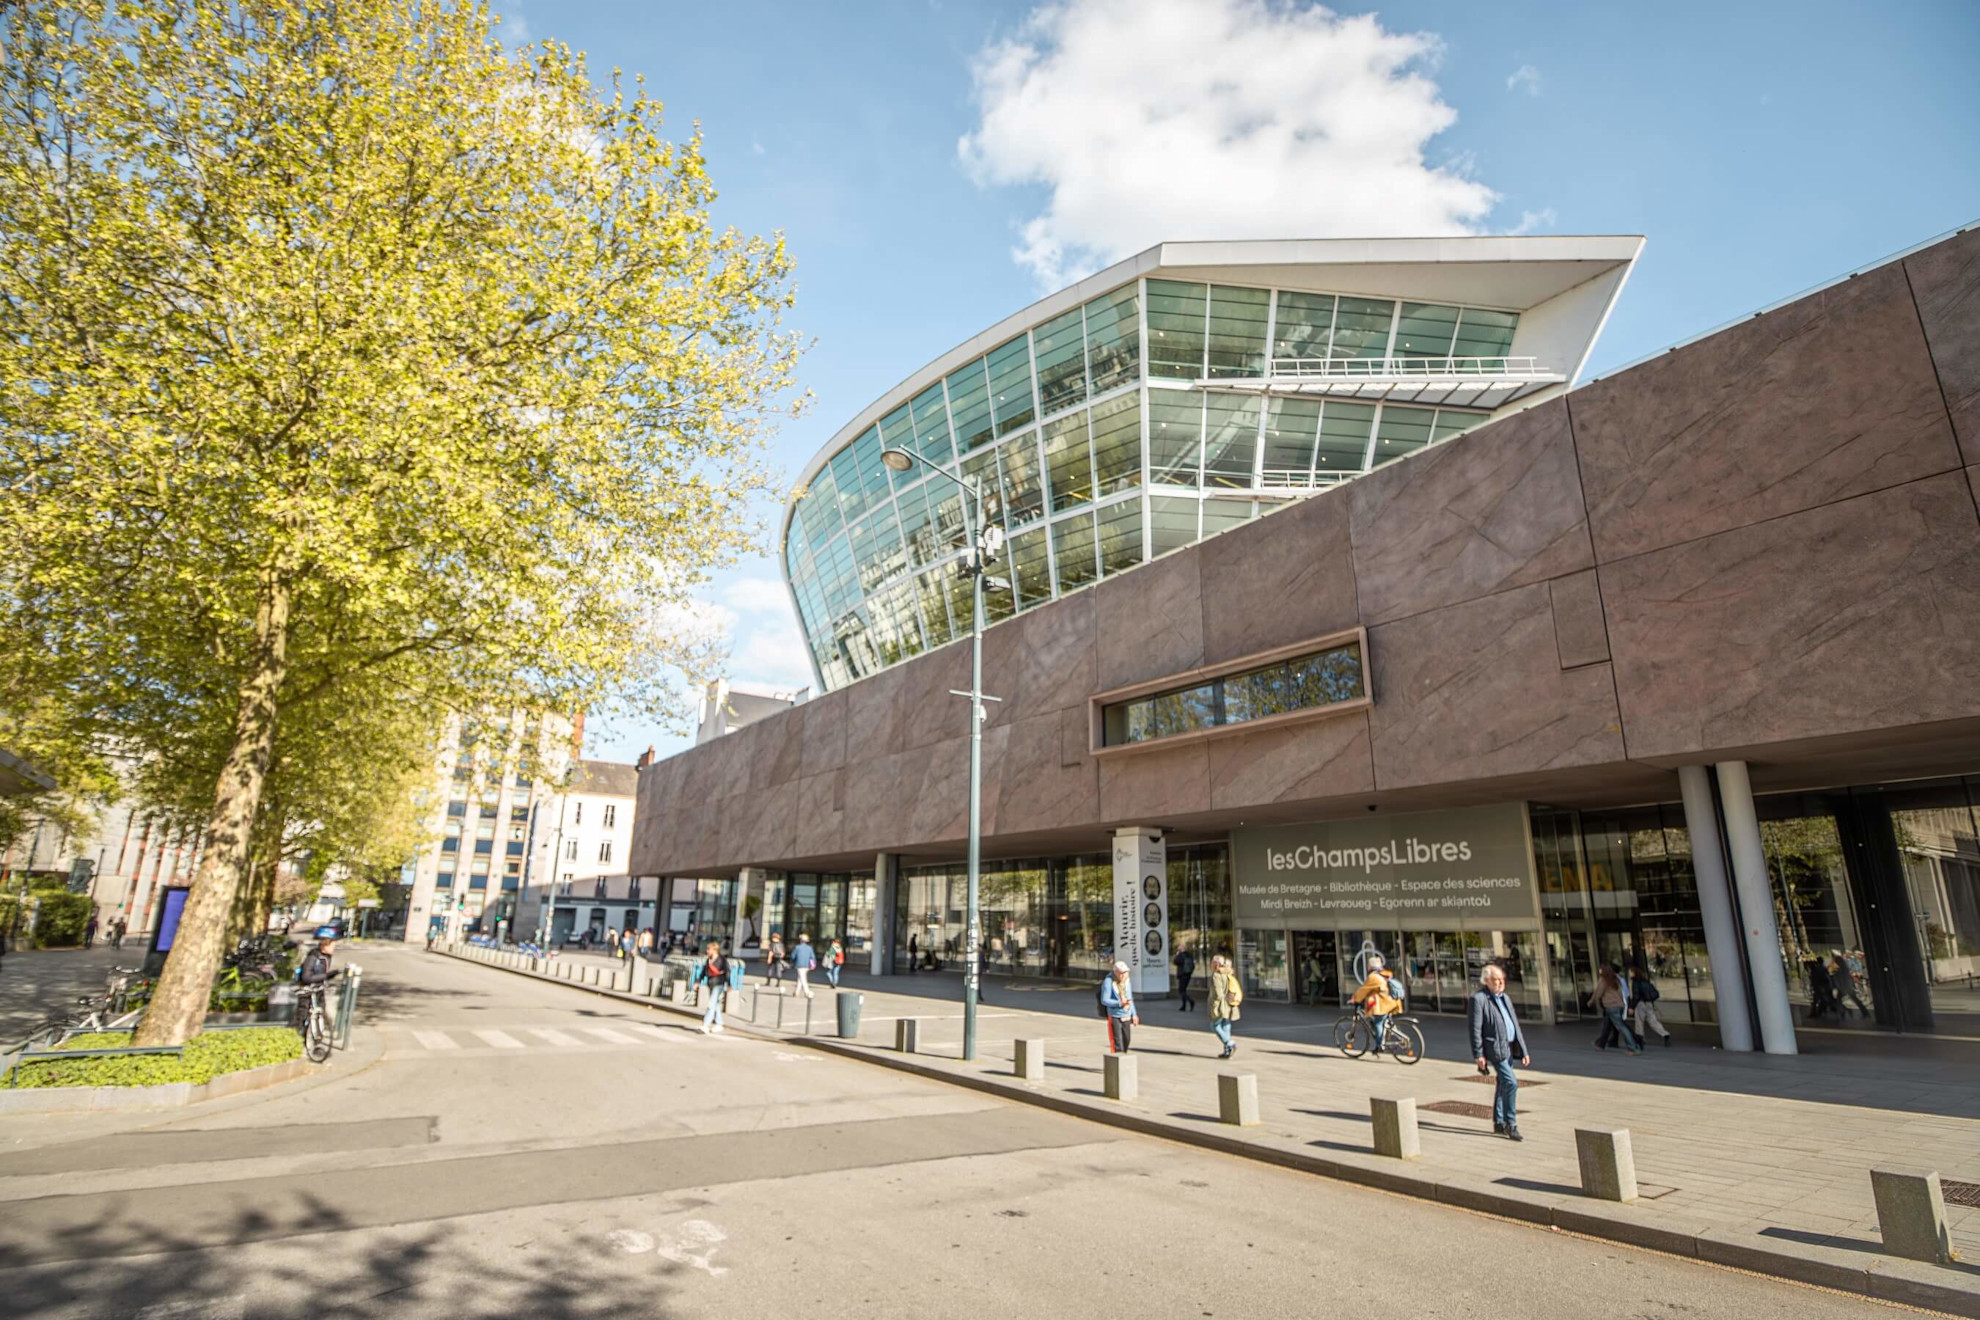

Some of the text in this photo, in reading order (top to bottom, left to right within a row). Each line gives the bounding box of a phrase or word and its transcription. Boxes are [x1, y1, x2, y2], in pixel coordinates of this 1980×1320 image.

[1267, 838, 1472, 874] lesChampsLibres
[1239, 884, 1266, 895] Musée
[1267, 884, 1279, 894] de
[1280, 883, 1322, 895] Bretagne
[1329, 881, 1392, 893] Bibliothèque
[1401, 880, 1441, 892] Espace
[1442, 877, 1464, 889] des
[1466, 876, 1521, 889] sciences
[1128, 888, 1137, 930] histoire
[1284, 898, 1313, 909] Breizh
[1320, 898, 1371, 910] Levraoueg
[1379, 897, 1425, 910] Egorenn
[1427, 899, 1439, 908] ar
[1129, 932, 1139, 966] quelle
